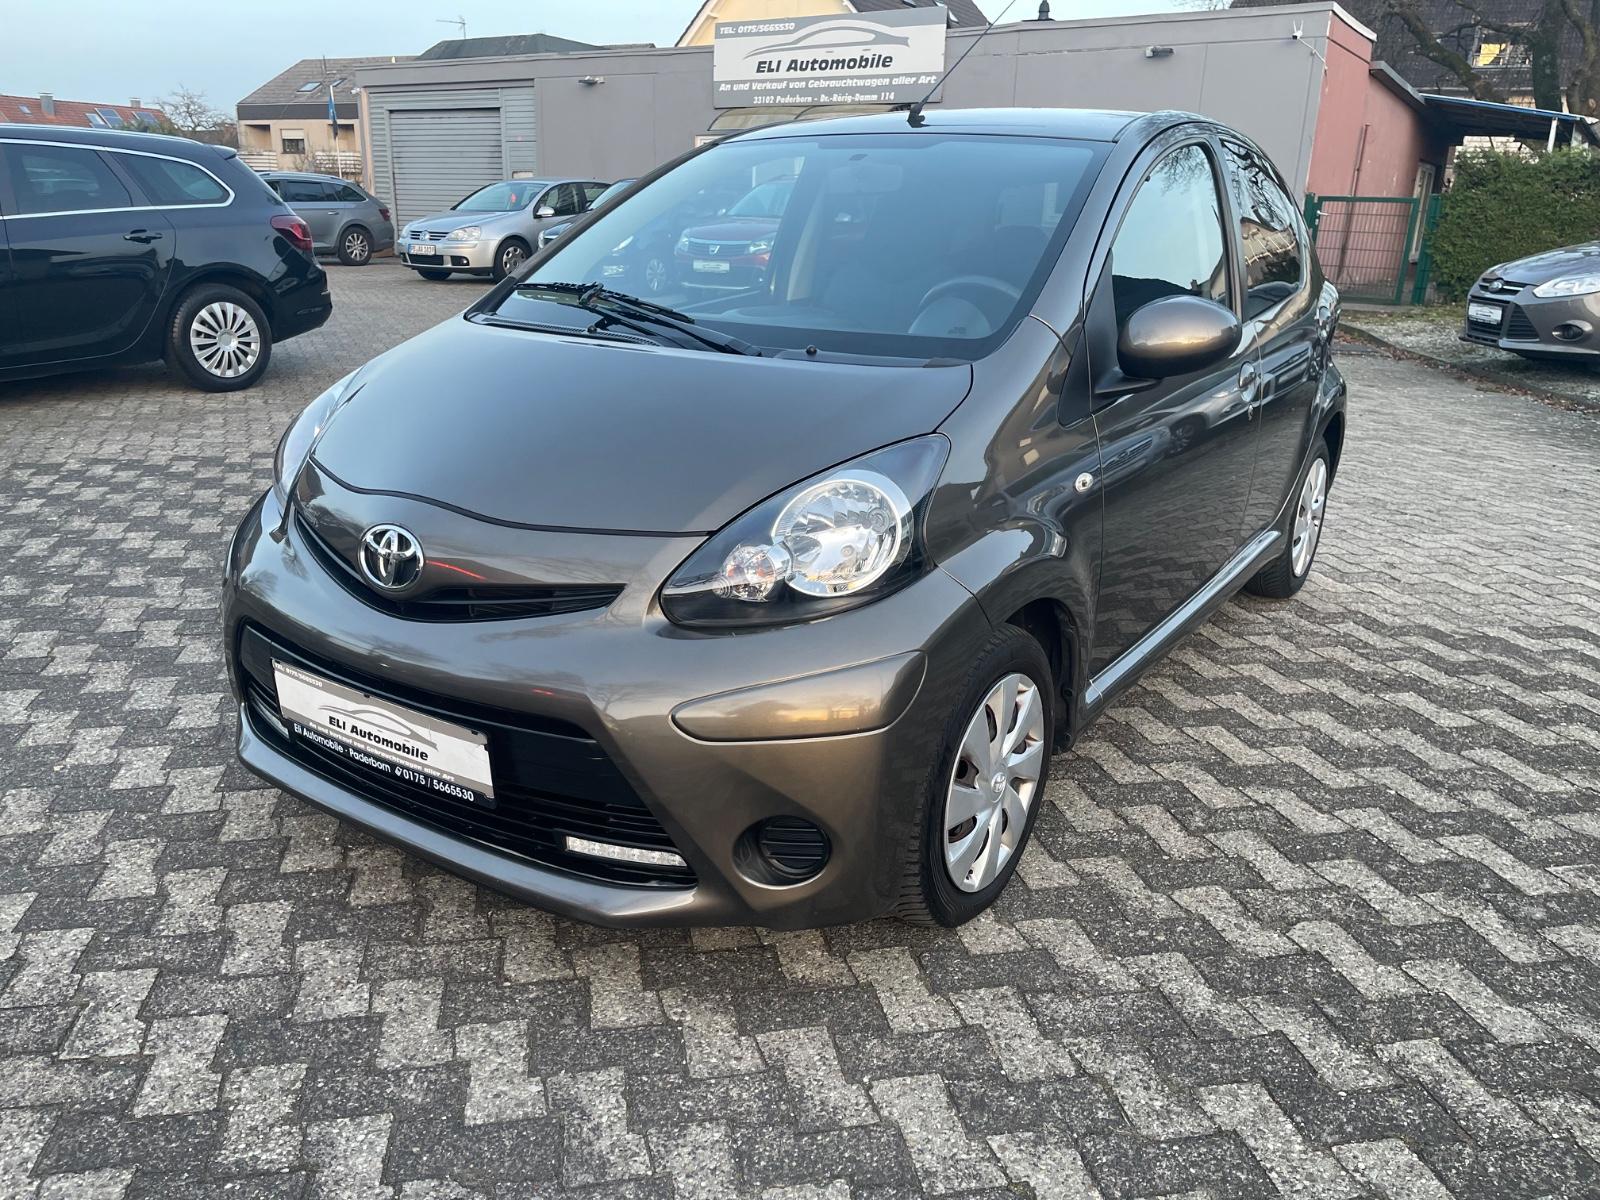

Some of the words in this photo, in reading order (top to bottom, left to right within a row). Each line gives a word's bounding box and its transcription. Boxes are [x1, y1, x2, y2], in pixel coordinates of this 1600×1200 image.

[720, 26, 736, 34] TEL:
[738, 22, 796, 33] 0175/5665530
[755, 60, 782, 73] ELI
[786, 54, 893, 72] Automobile
[719, 83, 731, 91] An
[733, 82, 749, 90] und
[751, 80, 788, 90] Verkauf
[789, 81, 806, 89] von
[808, 77, 890, 88] Gebrauchtwagen
[892, 75, 916, 85] aller
[918, 75, 937, 84] Art
[753, 95, 775, 104] 33102
[776, 94, 812, 103] Paderborn
[881, 92, 895, 100] 114
[328, 716, 346, 731] ELI
[350, 725, 429, 761] Automobile
[293, 723, 302, 734] Eli
[303, 727, 344, 753] Automobile
[349, 748, 391, 773] Paderborn
[403, 769, 426, 785] 0175
[433, 780, 474, 802] 5665530
